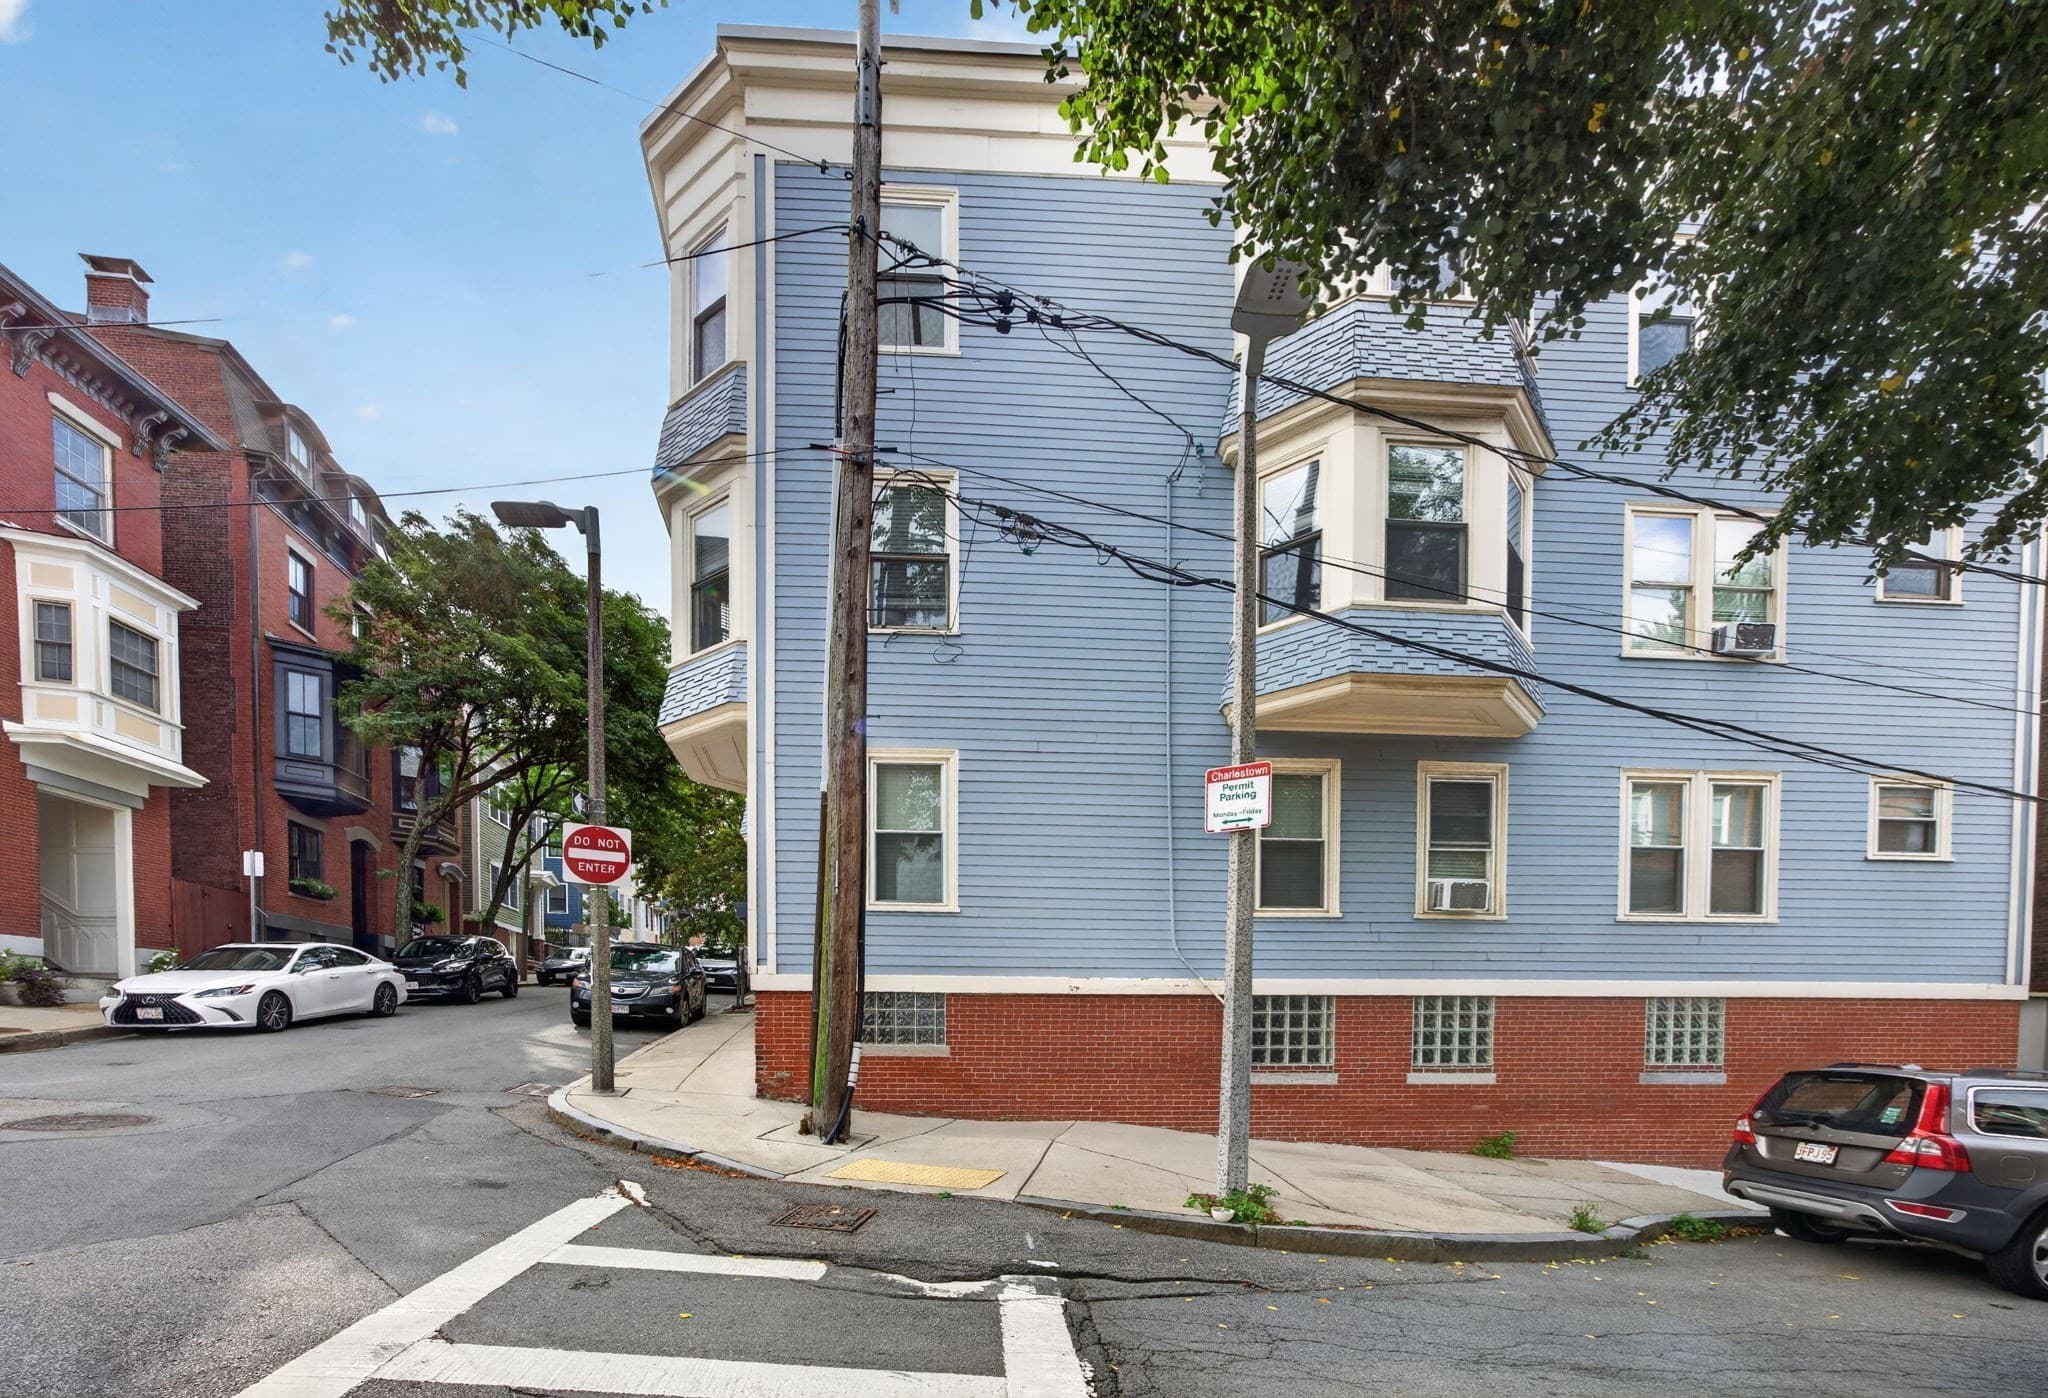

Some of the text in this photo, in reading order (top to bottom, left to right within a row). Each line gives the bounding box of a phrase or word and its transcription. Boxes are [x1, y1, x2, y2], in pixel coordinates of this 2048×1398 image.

[1211, 767, 1268, 781] Charlestown
[1222, 780, 1254, 792] Permit
[1220, 791, 1257, 801] Parking
[574, 835, 620, 849] DO NOT
[578, 861, 616, 874] ENTER
